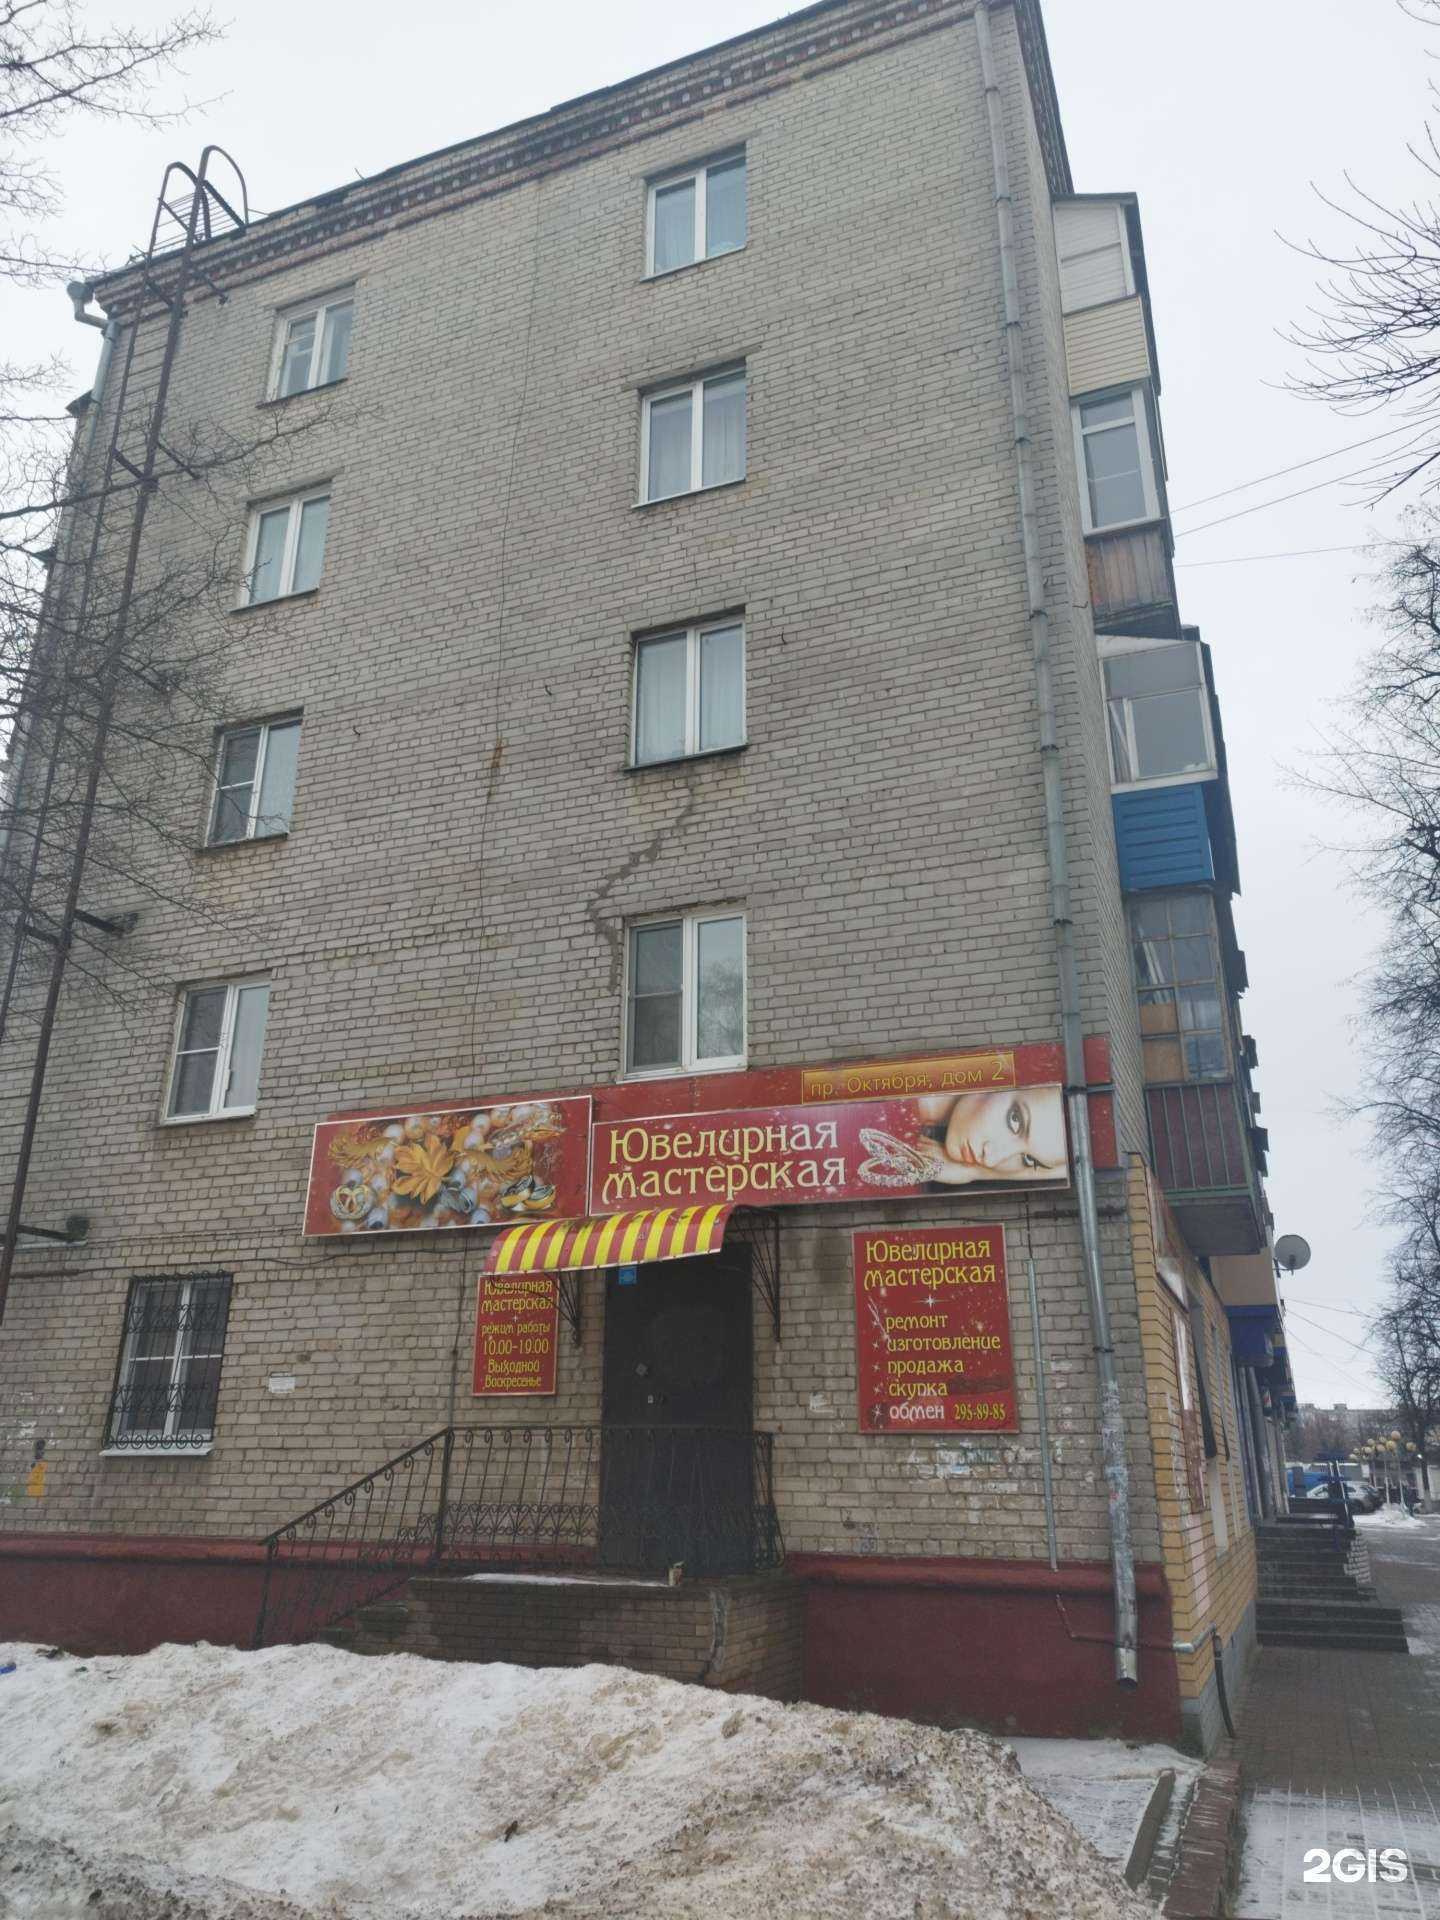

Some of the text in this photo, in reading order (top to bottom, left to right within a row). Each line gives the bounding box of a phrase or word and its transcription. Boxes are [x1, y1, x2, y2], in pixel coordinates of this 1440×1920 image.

[810, 1061, 1005, 1100] пр. Октября, дом 2
[609, 1120, 839, 1164] Ювелирная
[866, 1240, 991, 1264] Ювелирная
[484, 1279, 552, 1297] Ювелирная
[481, 1321, 551, 1336] режим работы
[885, 1315, 948, 1333] ремонт
[887, 1335, 1001, 1352] изготовление
[887, 1359, 965, 1378] продажа
[888, 1380, 949, 1399] скупка
[889, 1401, 944, 1421] обмен
